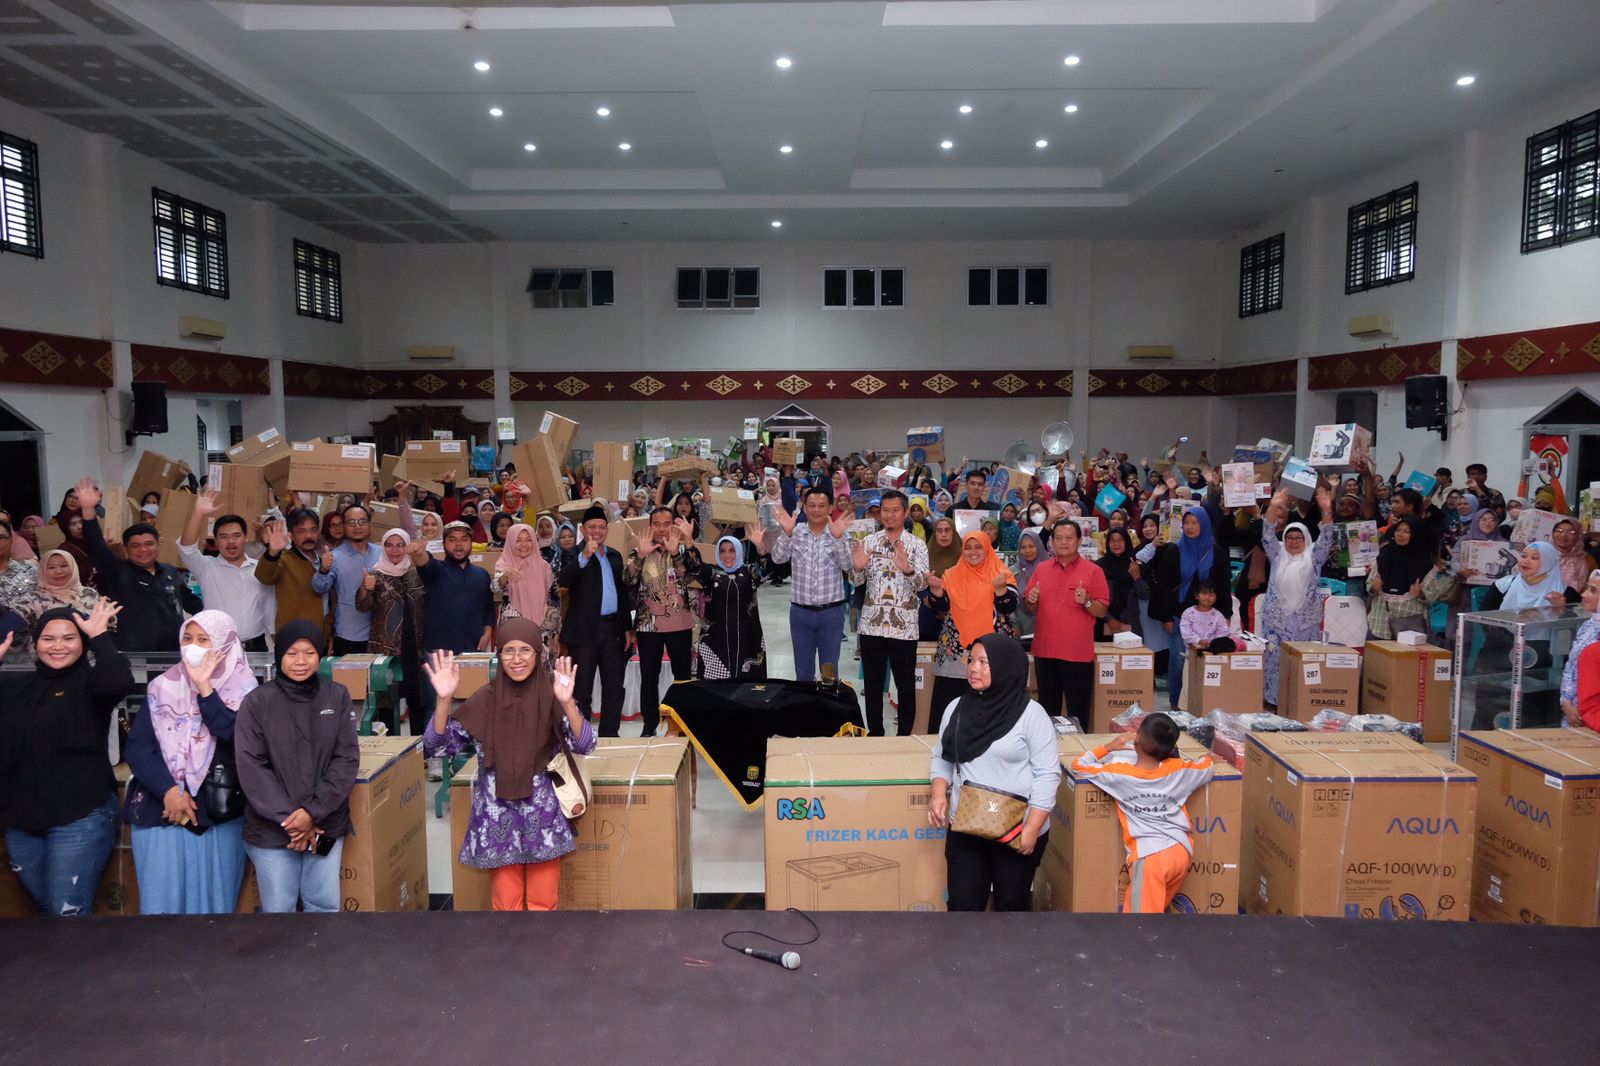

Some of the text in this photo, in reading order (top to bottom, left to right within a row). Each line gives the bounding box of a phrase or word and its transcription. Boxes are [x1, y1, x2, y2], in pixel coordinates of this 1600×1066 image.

[777, 797, 826, 821] RSA
[1504, 795, 1552, 829] AQUA
[806, 828, 861, 842] FRIZER
[866, 828, 909, 841] KACA
[1386, 817, 1460, 835] AQUA
[1346, 862, 1457, 878] AQF-100(W)(D)
